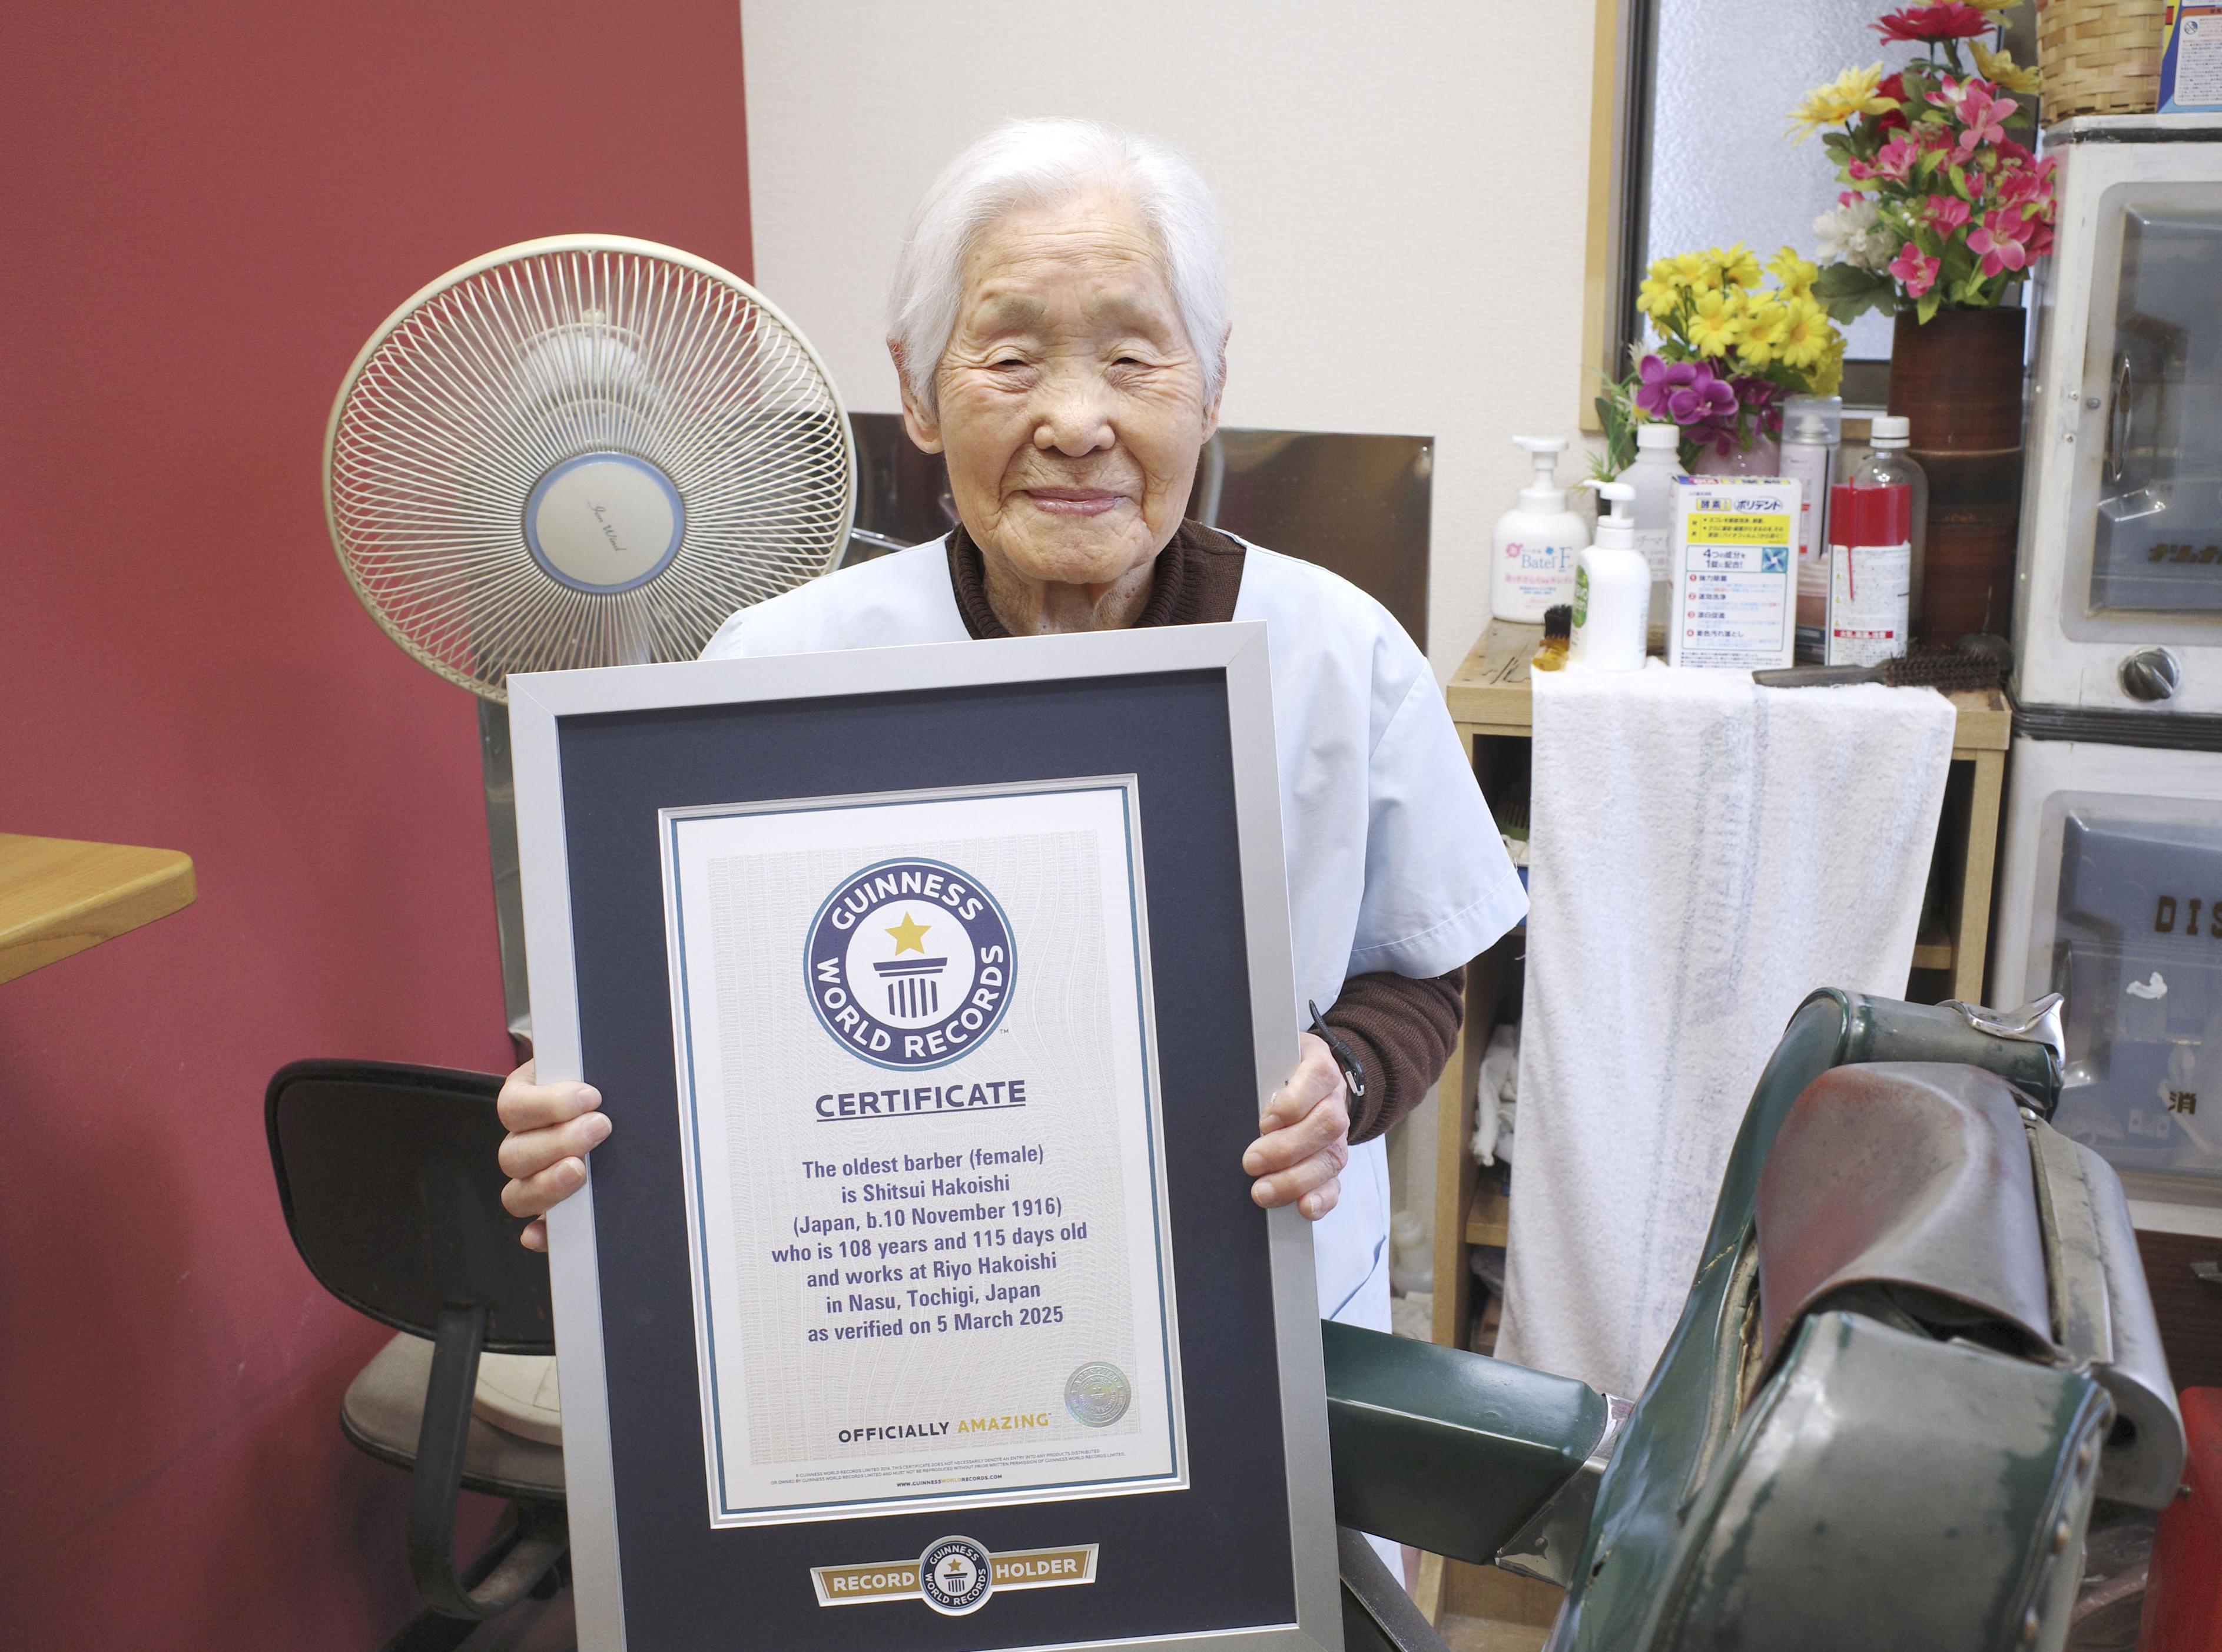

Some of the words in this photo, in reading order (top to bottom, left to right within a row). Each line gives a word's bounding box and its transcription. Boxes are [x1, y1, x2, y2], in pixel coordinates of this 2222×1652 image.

[1737, 500, 1780, 510] ポリデント
[603, 525, 626, 551] Wind
[833, 871, 984, 930] GUINNESS
[817, 956, 891, 1053] WORLD
[904, 944, 1004, 1058] RECORDS
[816, 1080, 1026, 1119] CERTIFICATE
[2168, 1090, 2197, 1115] 消
[802, 1161, 836, 1178] The
[843, 1157, 898, 1176] oldest
[904, 1152, 963, 1171] barber
[970, 1144, 1043, 1170] (female)
[842, 1186, 857, 1203] is
[863, 1180, 925, 1202] Shitsui
[932, 1174, 1009, 1196] Hakoishi
[794, 1216, 860, 1238] (Japan,
[867, 1209, 905, 1228] b.10
[912, 1203, 1005, 1225] November
[1012, 1197, 1062, 1218] 1916)
[771, 1245, 811, 1262] who
[818, 1243, 833, 1259] is
[840, 1239, 871, 1258] 108
[878, 1239, 927, 1259] years
[934, 1232, 966, 1250] and
[974, 1229, 1005, 1248] 115
[1013, 1228, 1054, 1246] days
[1061, 1222, 1087, 1240] old
[807, 1269, 839, 1287] and
[845, 1265, 903, 1284] works
[910, 1264, 927, 1279] at
[933, 1260, 971, 1281] Riyo
[979, 1252, 1056, 1274] Hakoishi
[827, 1296, 842, 1313] in
[849, 1294, 901, 1312] Nasu,
[907, 1286, 979, 1308] Tochigi,
[986, 1284, 1040, 1303] Japan
[808, 1329, 828, 1342] as
[834, 1319, 903, 1339] verified
[910, 1321, 930, 1334] on
[937, 1315, 947, 1332] 5
[954, 1310, 1013, 1331] March
[1020, 1306, 1063, 1325] 2025
[838, 1422, 949, 1443] OFFICIALLY
[958, 1414, 1049, 1432] AMAZING
[897, 1474, 1002, 1487] WWW.GUINNESSWORLDRECORDS.COM
[930, 1544, 980, 1565] GUINNESS
[834, 1571, 915, 1591] RECORD
[996, 1559, 1077, 1578] HOLDER
[924, 1573, 950, 1605] WORLD
[953, 1568, 987, 1605] RECORDS
